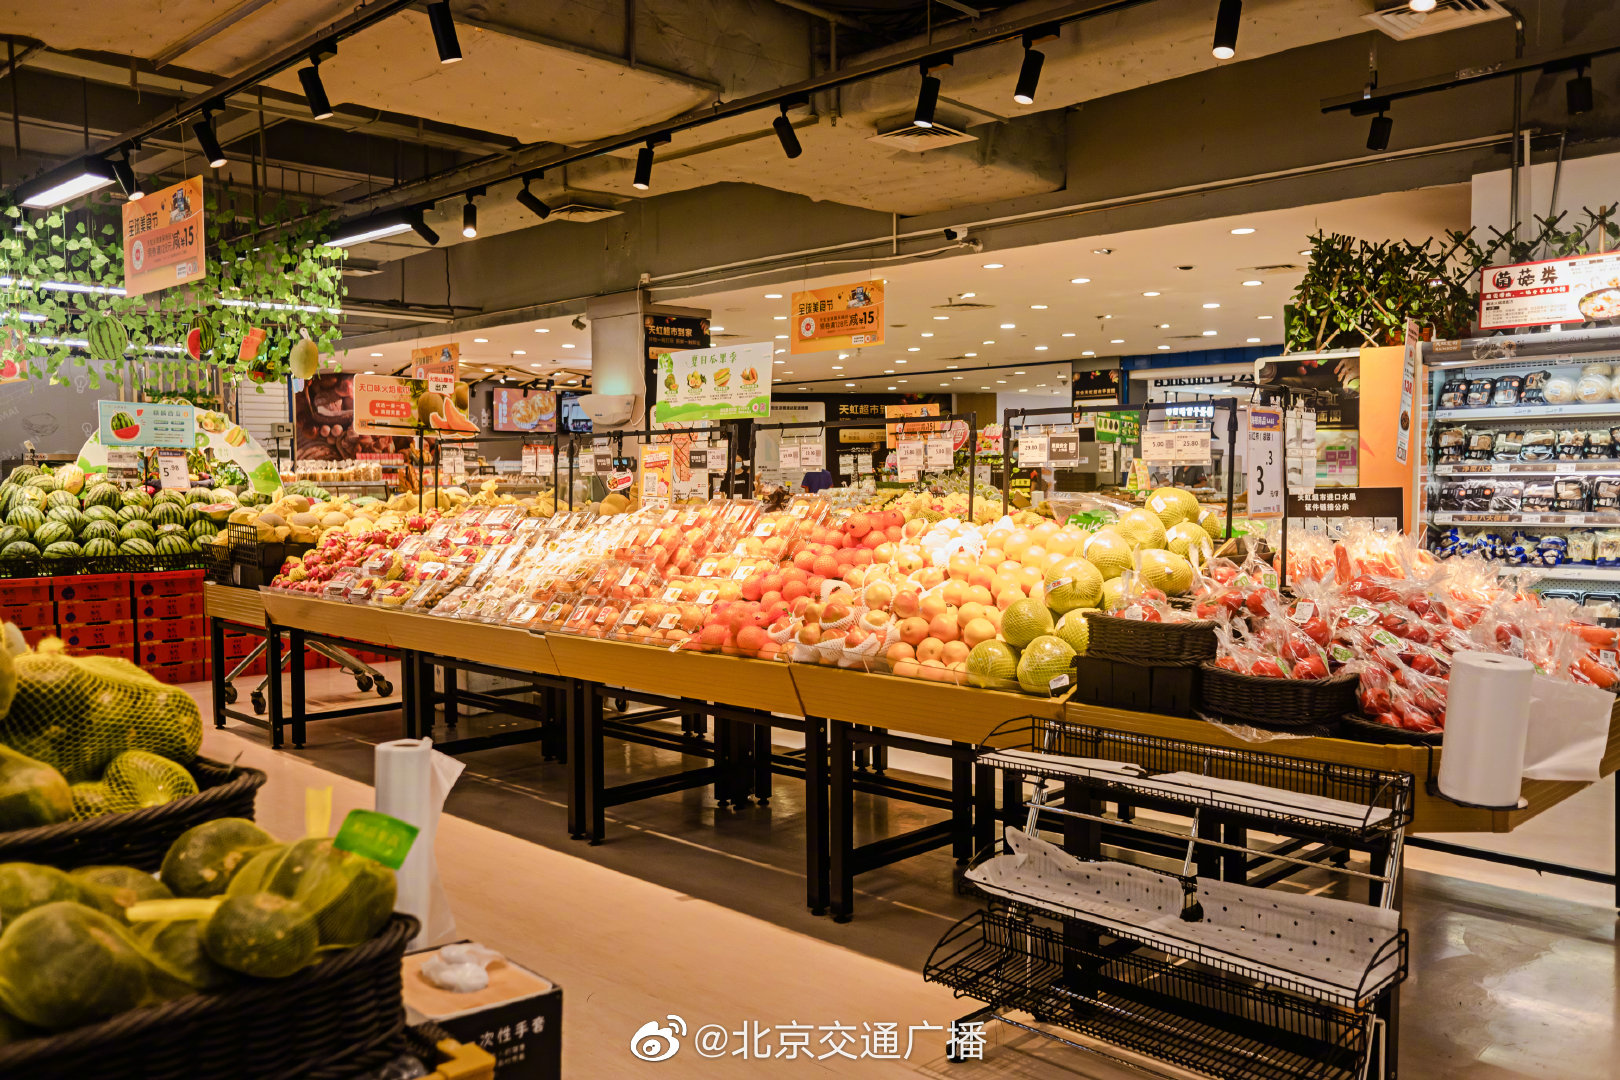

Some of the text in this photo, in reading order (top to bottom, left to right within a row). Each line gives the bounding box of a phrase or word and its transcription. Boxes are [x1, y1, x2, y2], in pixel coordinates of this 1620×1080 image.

[1495, 265, 1558, 289] 菌菇类
[798, 300, 833, 315] 全球美食节
[648, 325, 693, 337] 天虹超市到家
